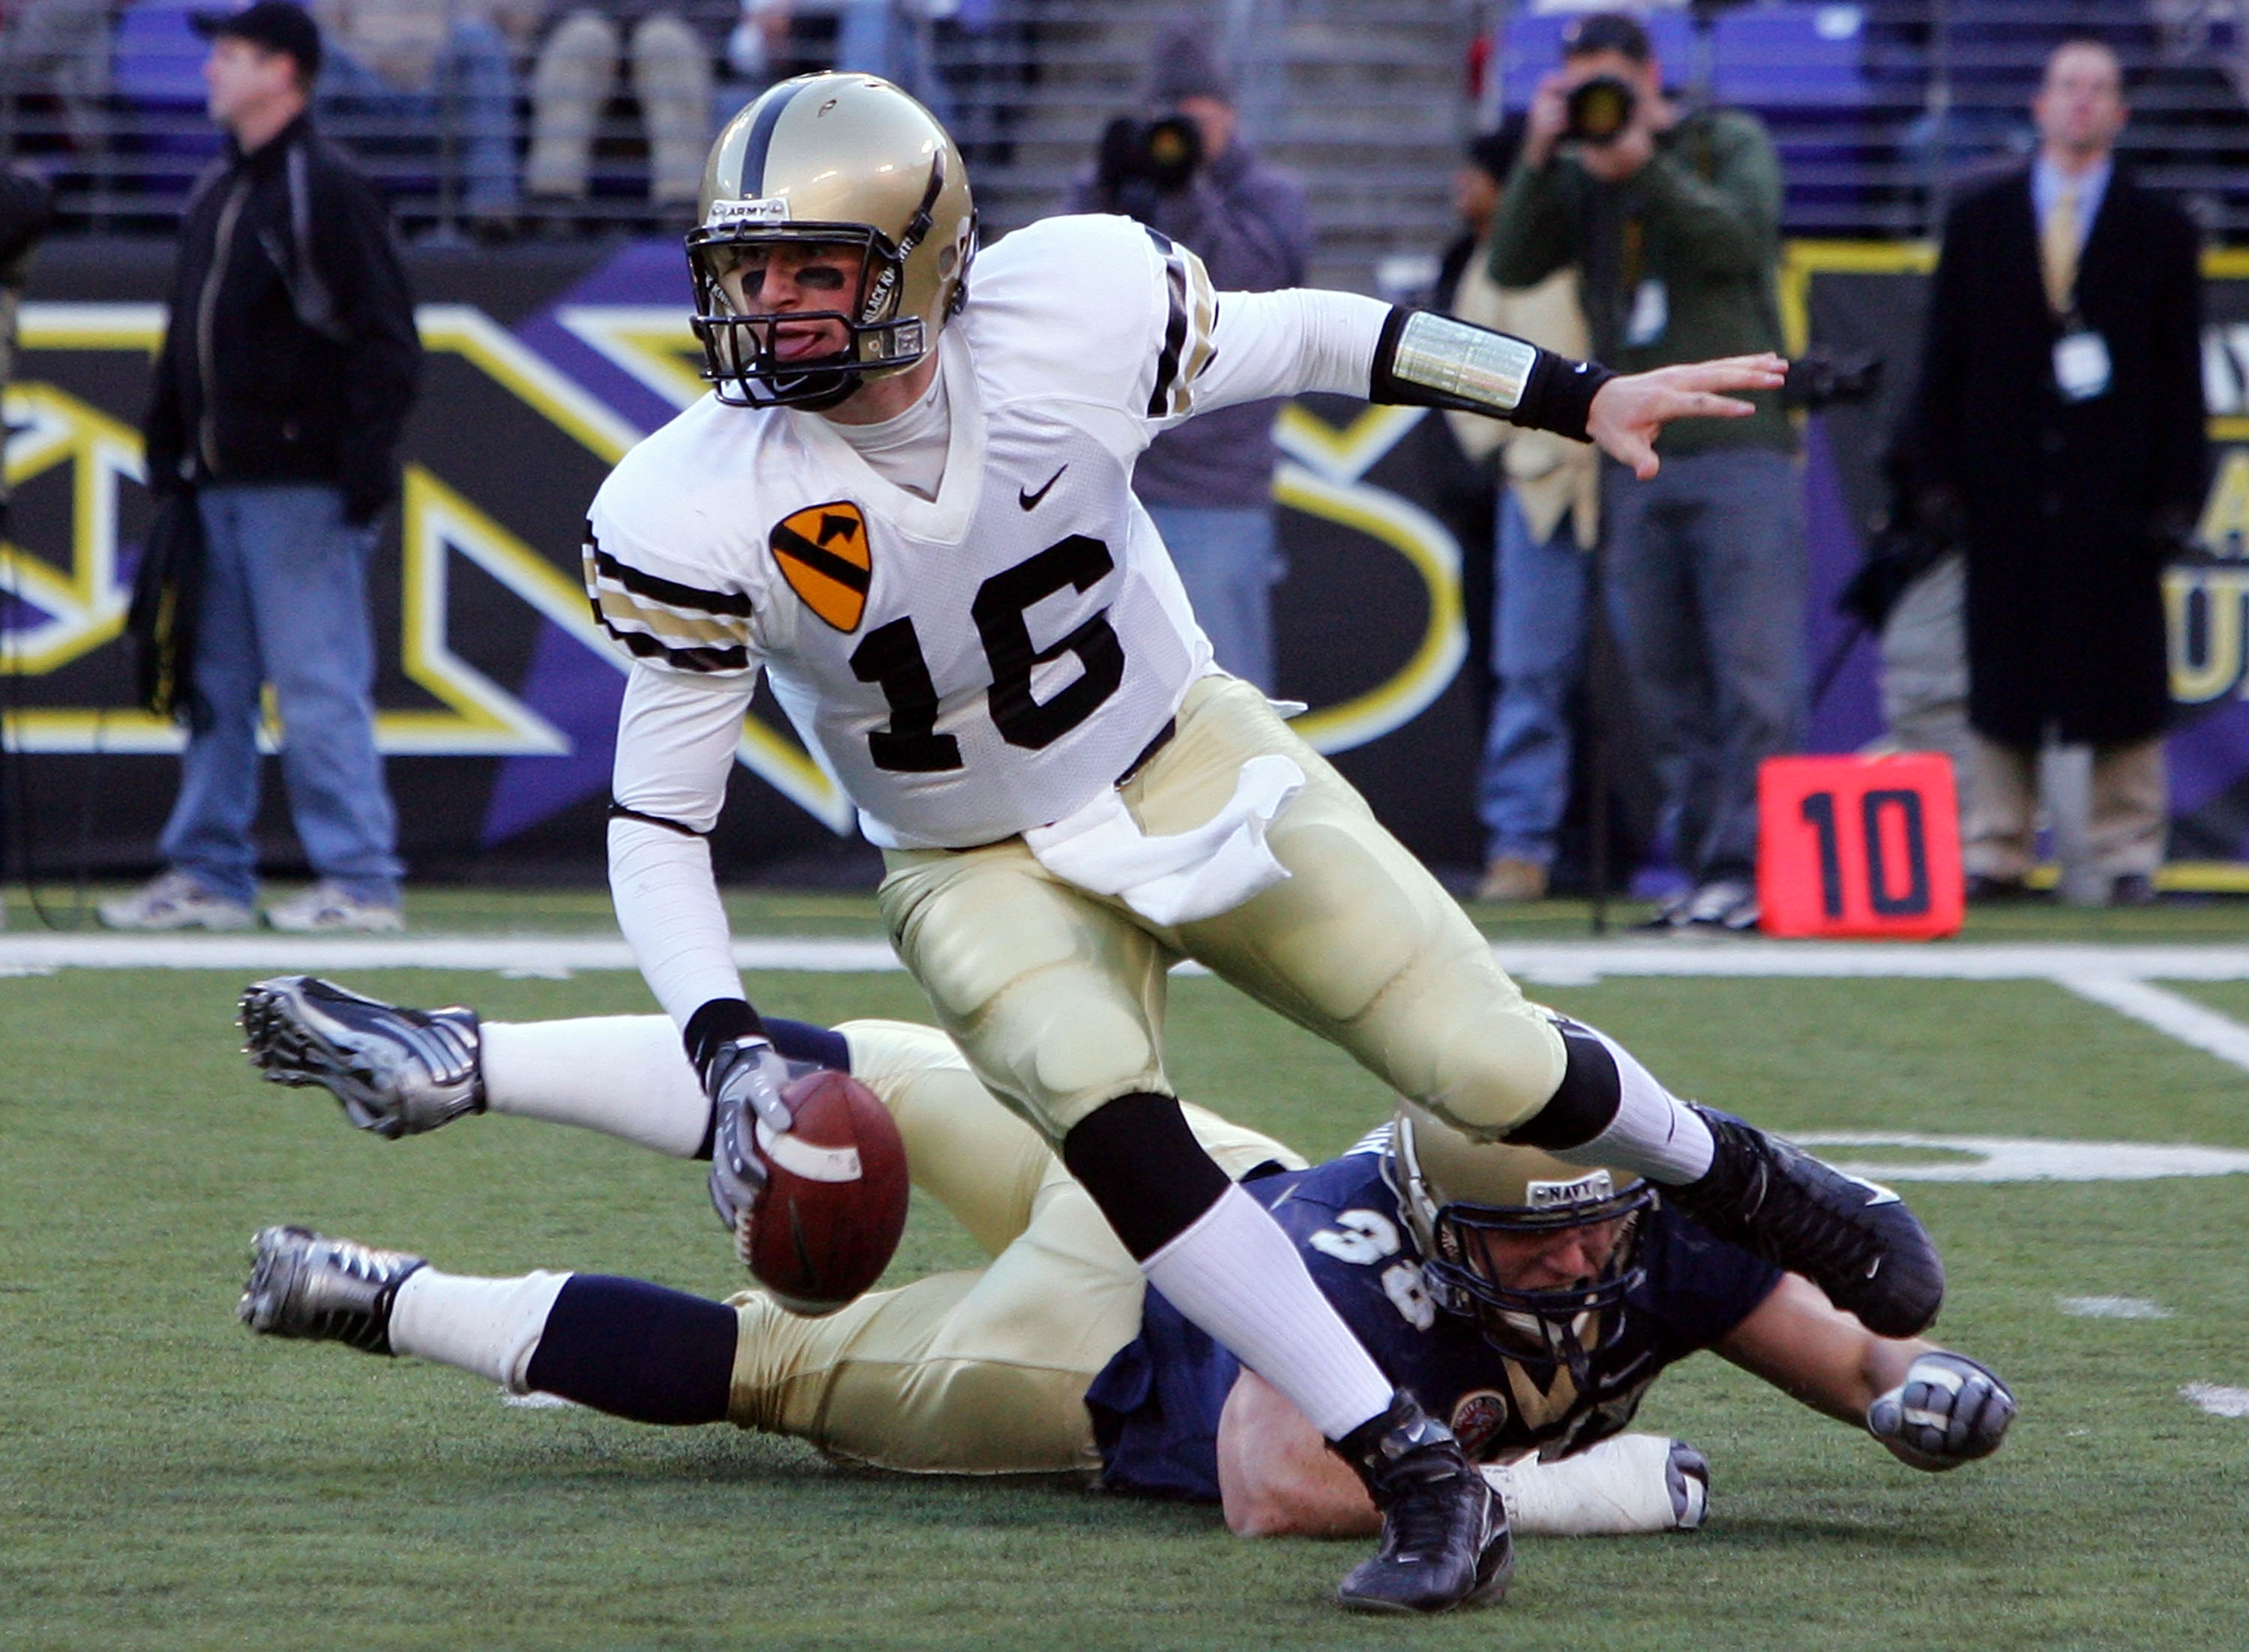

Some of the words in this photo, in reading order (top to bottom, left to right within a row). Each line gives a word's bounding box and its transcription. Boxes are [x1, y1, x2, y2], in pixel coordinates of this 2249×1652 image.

[727, 207, 766, 216] ARMY
[848, 534, 1125, 773] 16
[1801, 791, 1930, 917] 10
[1547, 1179, 1591, 1199] NAVY
